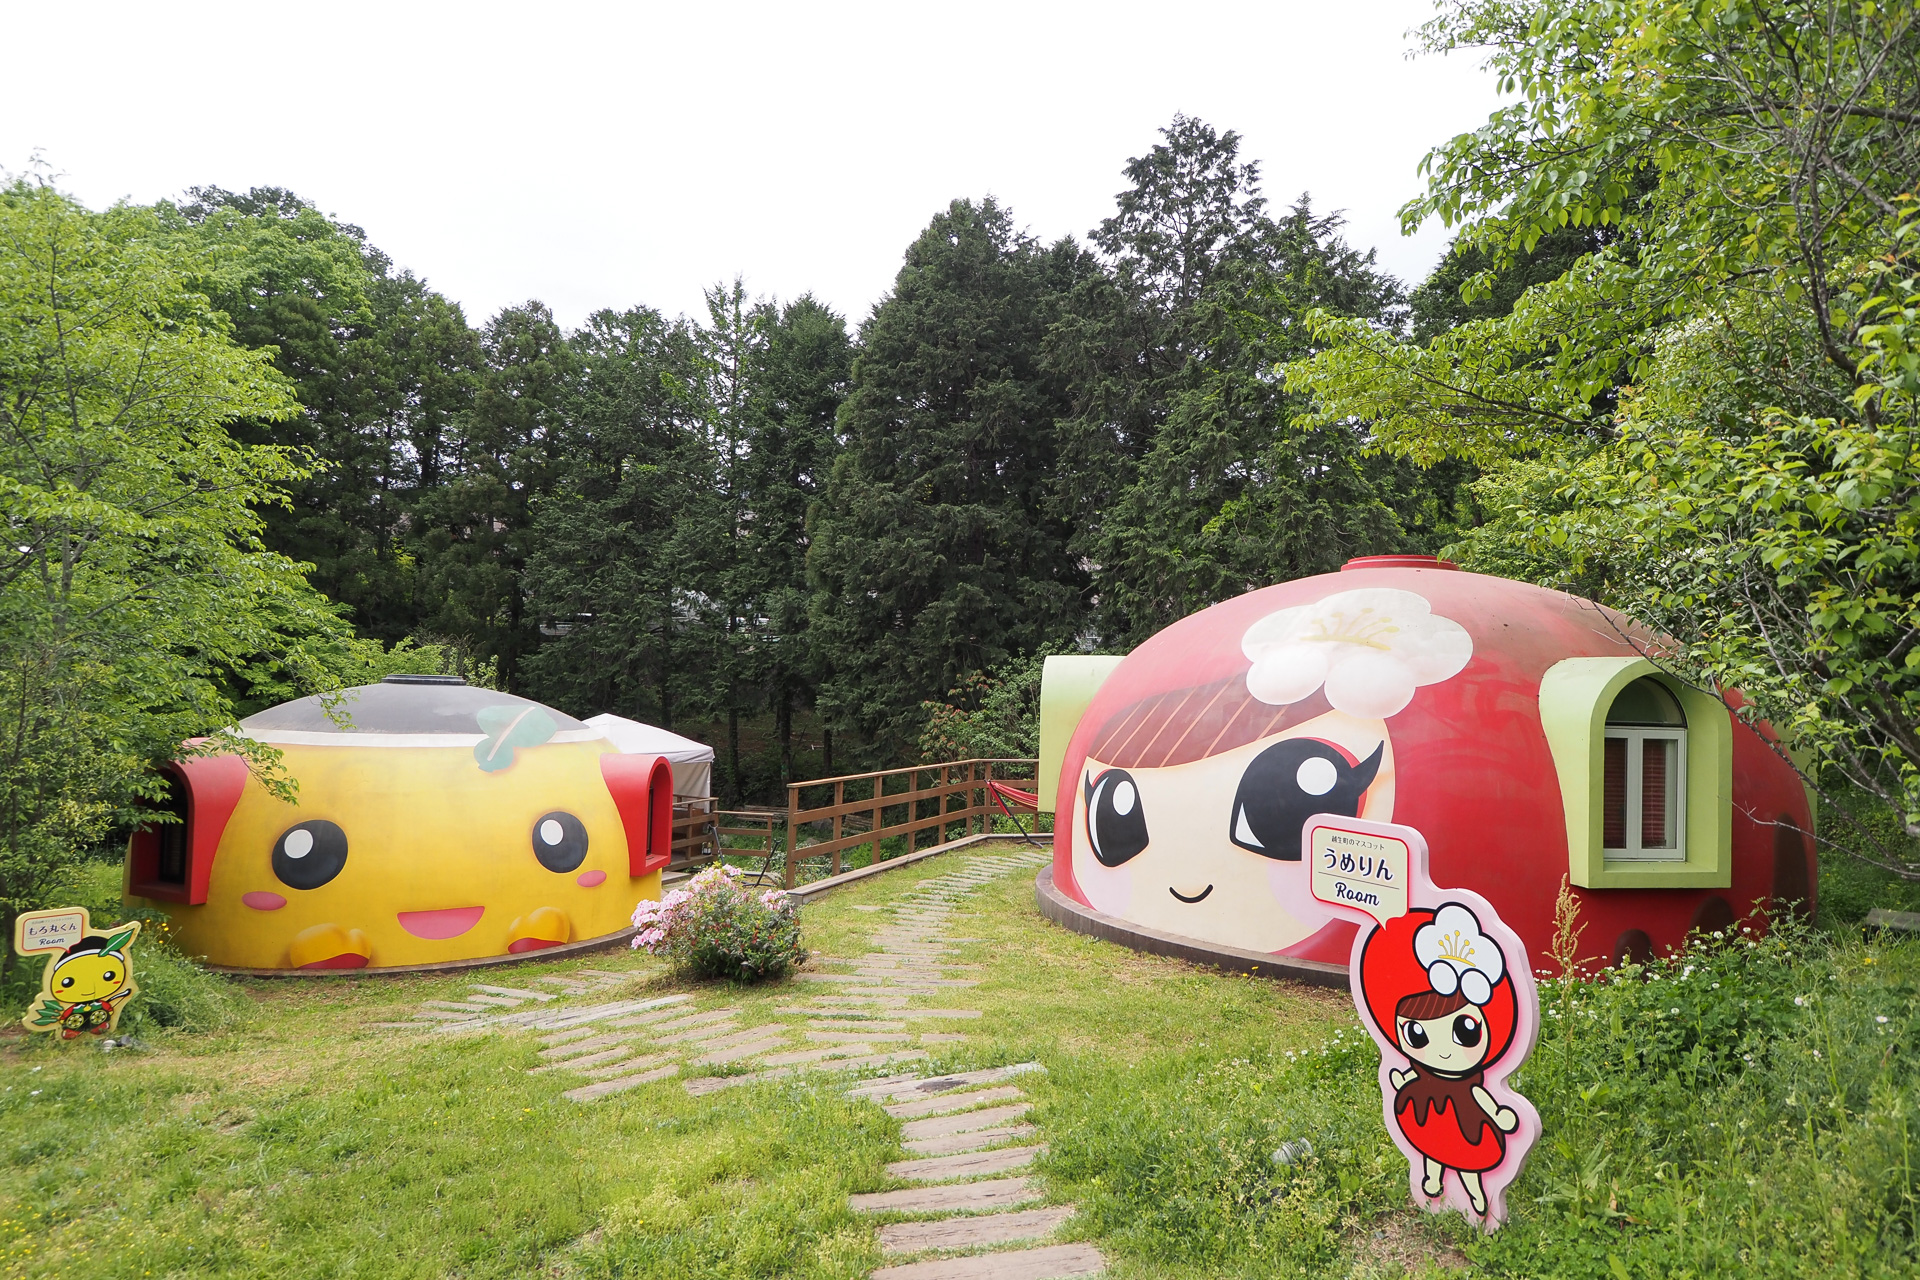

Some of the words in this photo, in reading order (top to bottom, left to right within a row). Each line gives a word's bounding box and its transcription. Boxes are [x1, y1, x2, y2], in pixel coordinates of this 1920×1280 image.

[1323, 847, 1394, 881] うめりん
[1334, 881, 1380, 907] Room
[29, 922, 77, 936] もろ丸くん
[39, 937, 65, 946] Room
